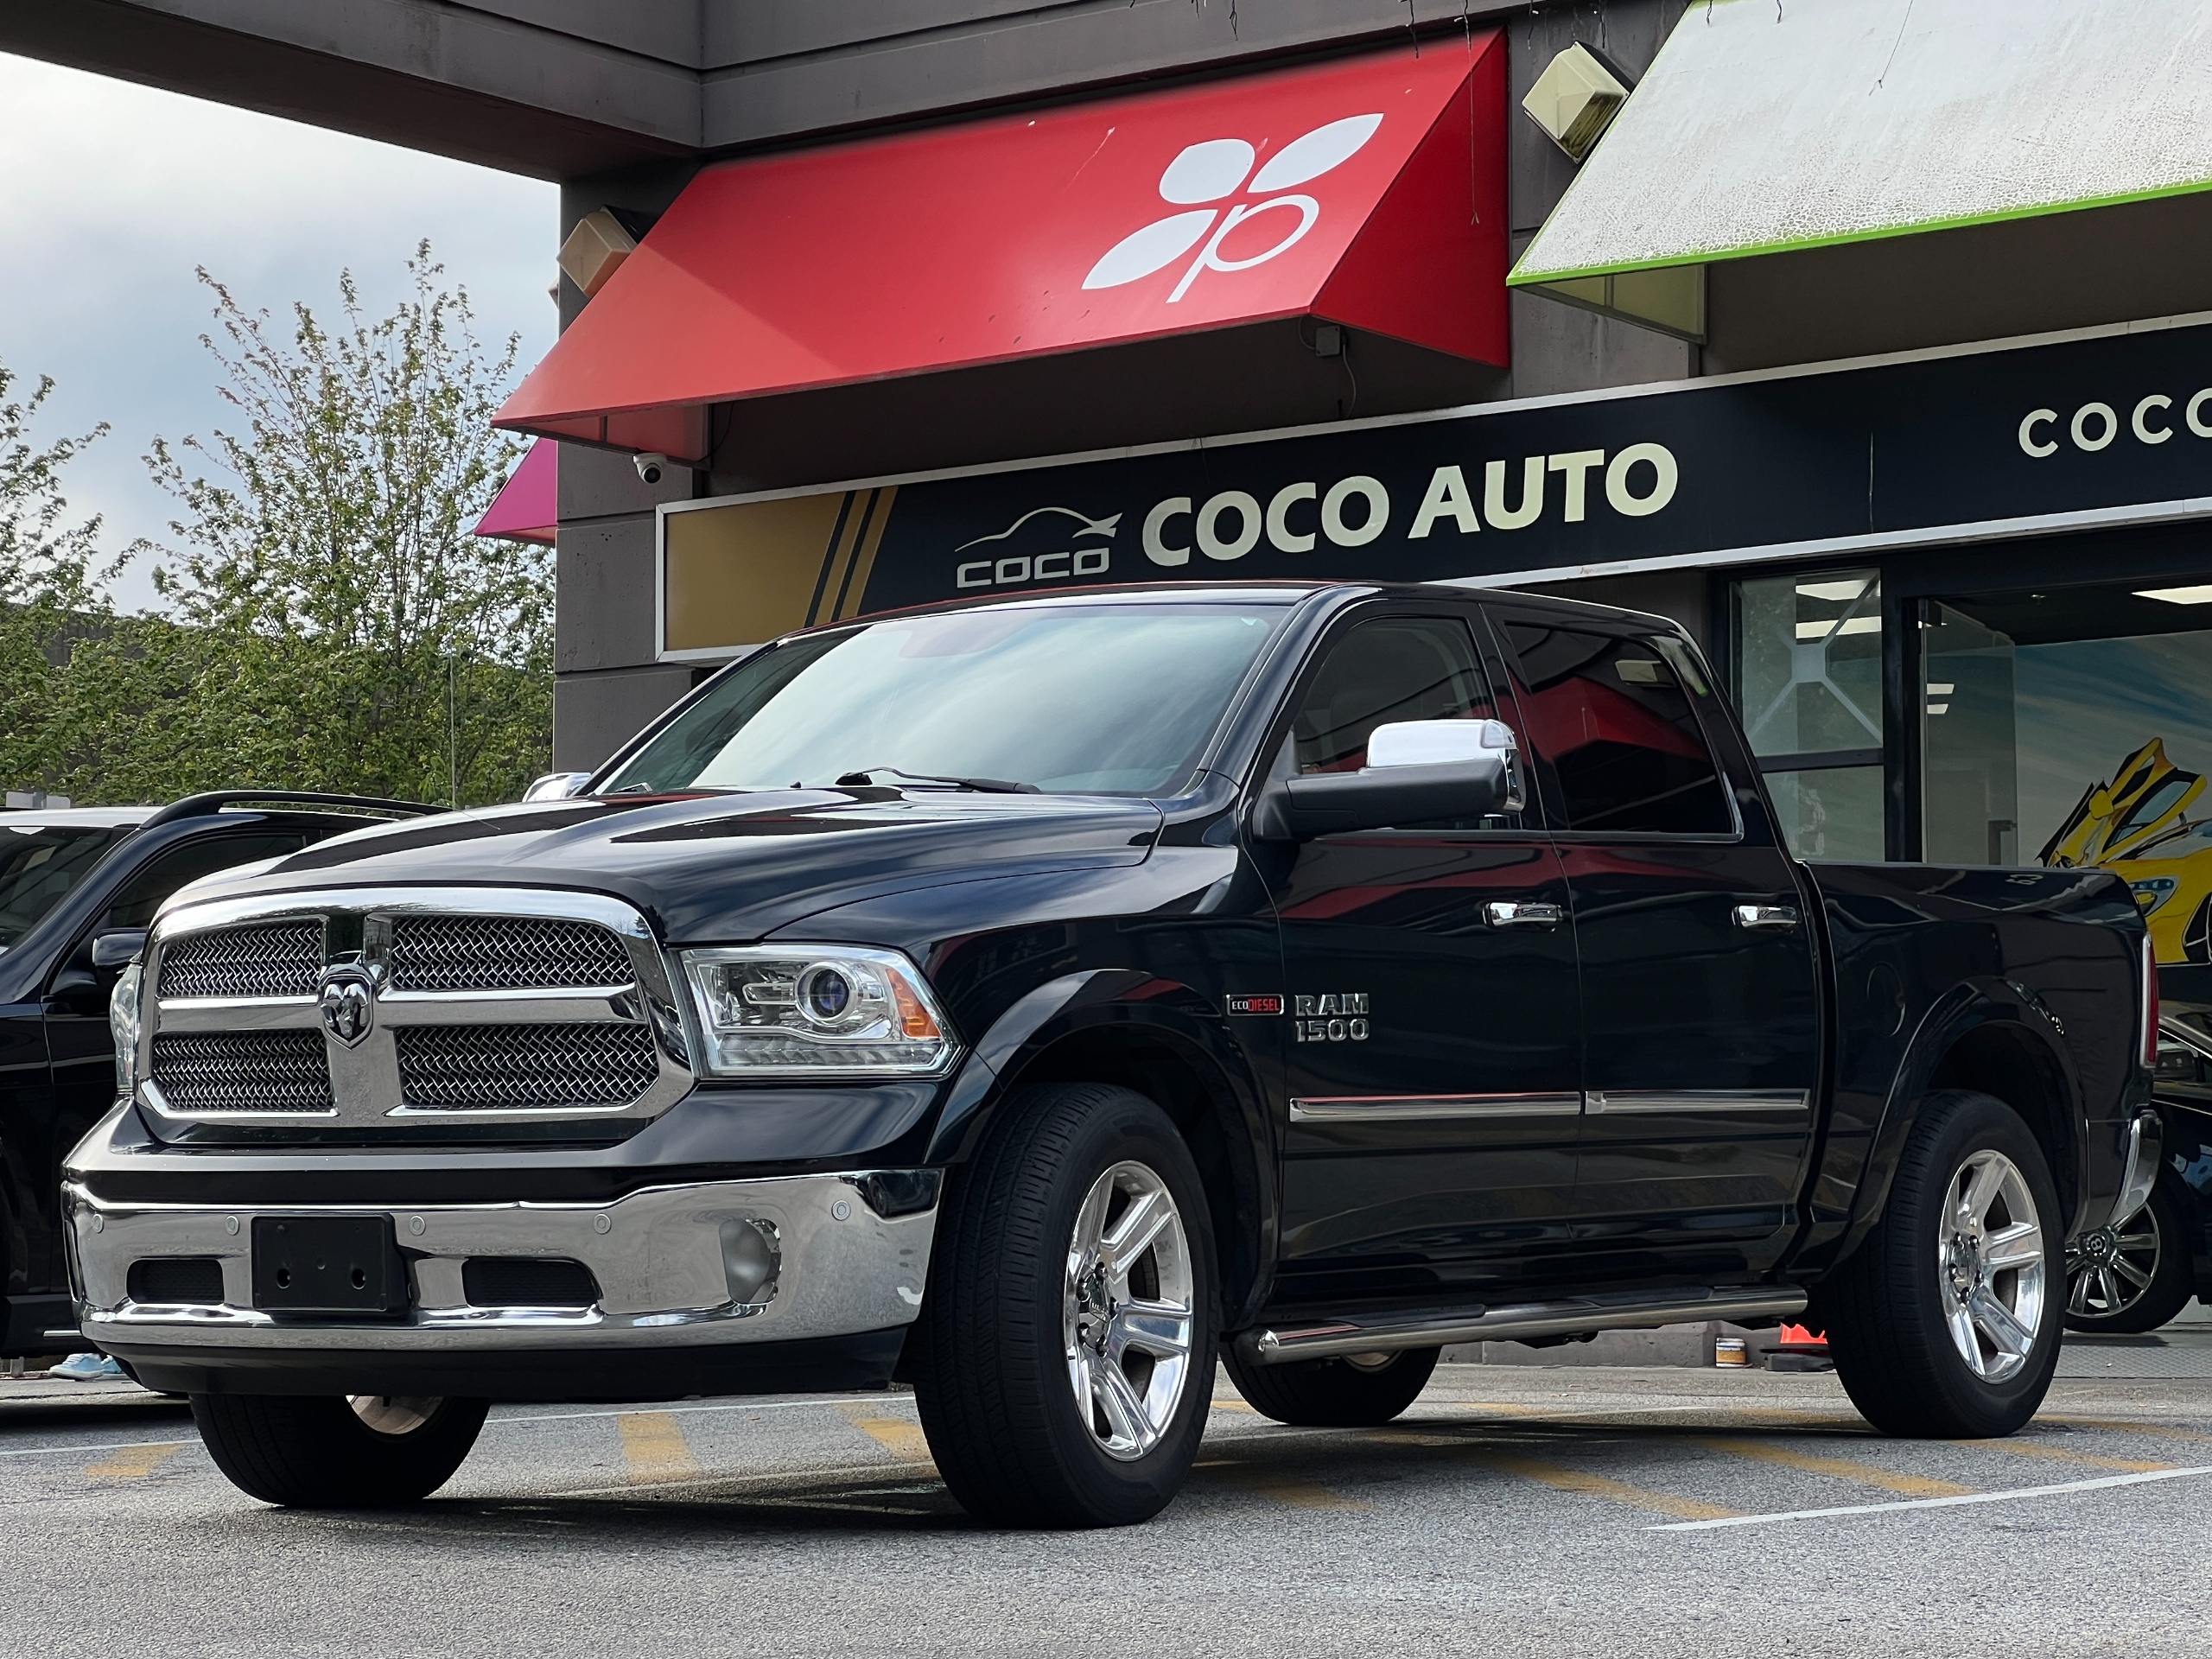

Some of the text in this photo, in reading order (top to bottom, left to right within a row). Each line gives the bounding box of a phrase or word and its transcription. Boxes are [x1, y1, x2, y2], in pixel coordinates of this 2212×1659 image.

[1142, 442, 1678, 567] COCO AUTO
[957, 547, 1109, 588] COCO
[1294, 993, 1370, 1017] RAM
[1294, 1018, 1370, 1043] 1500
